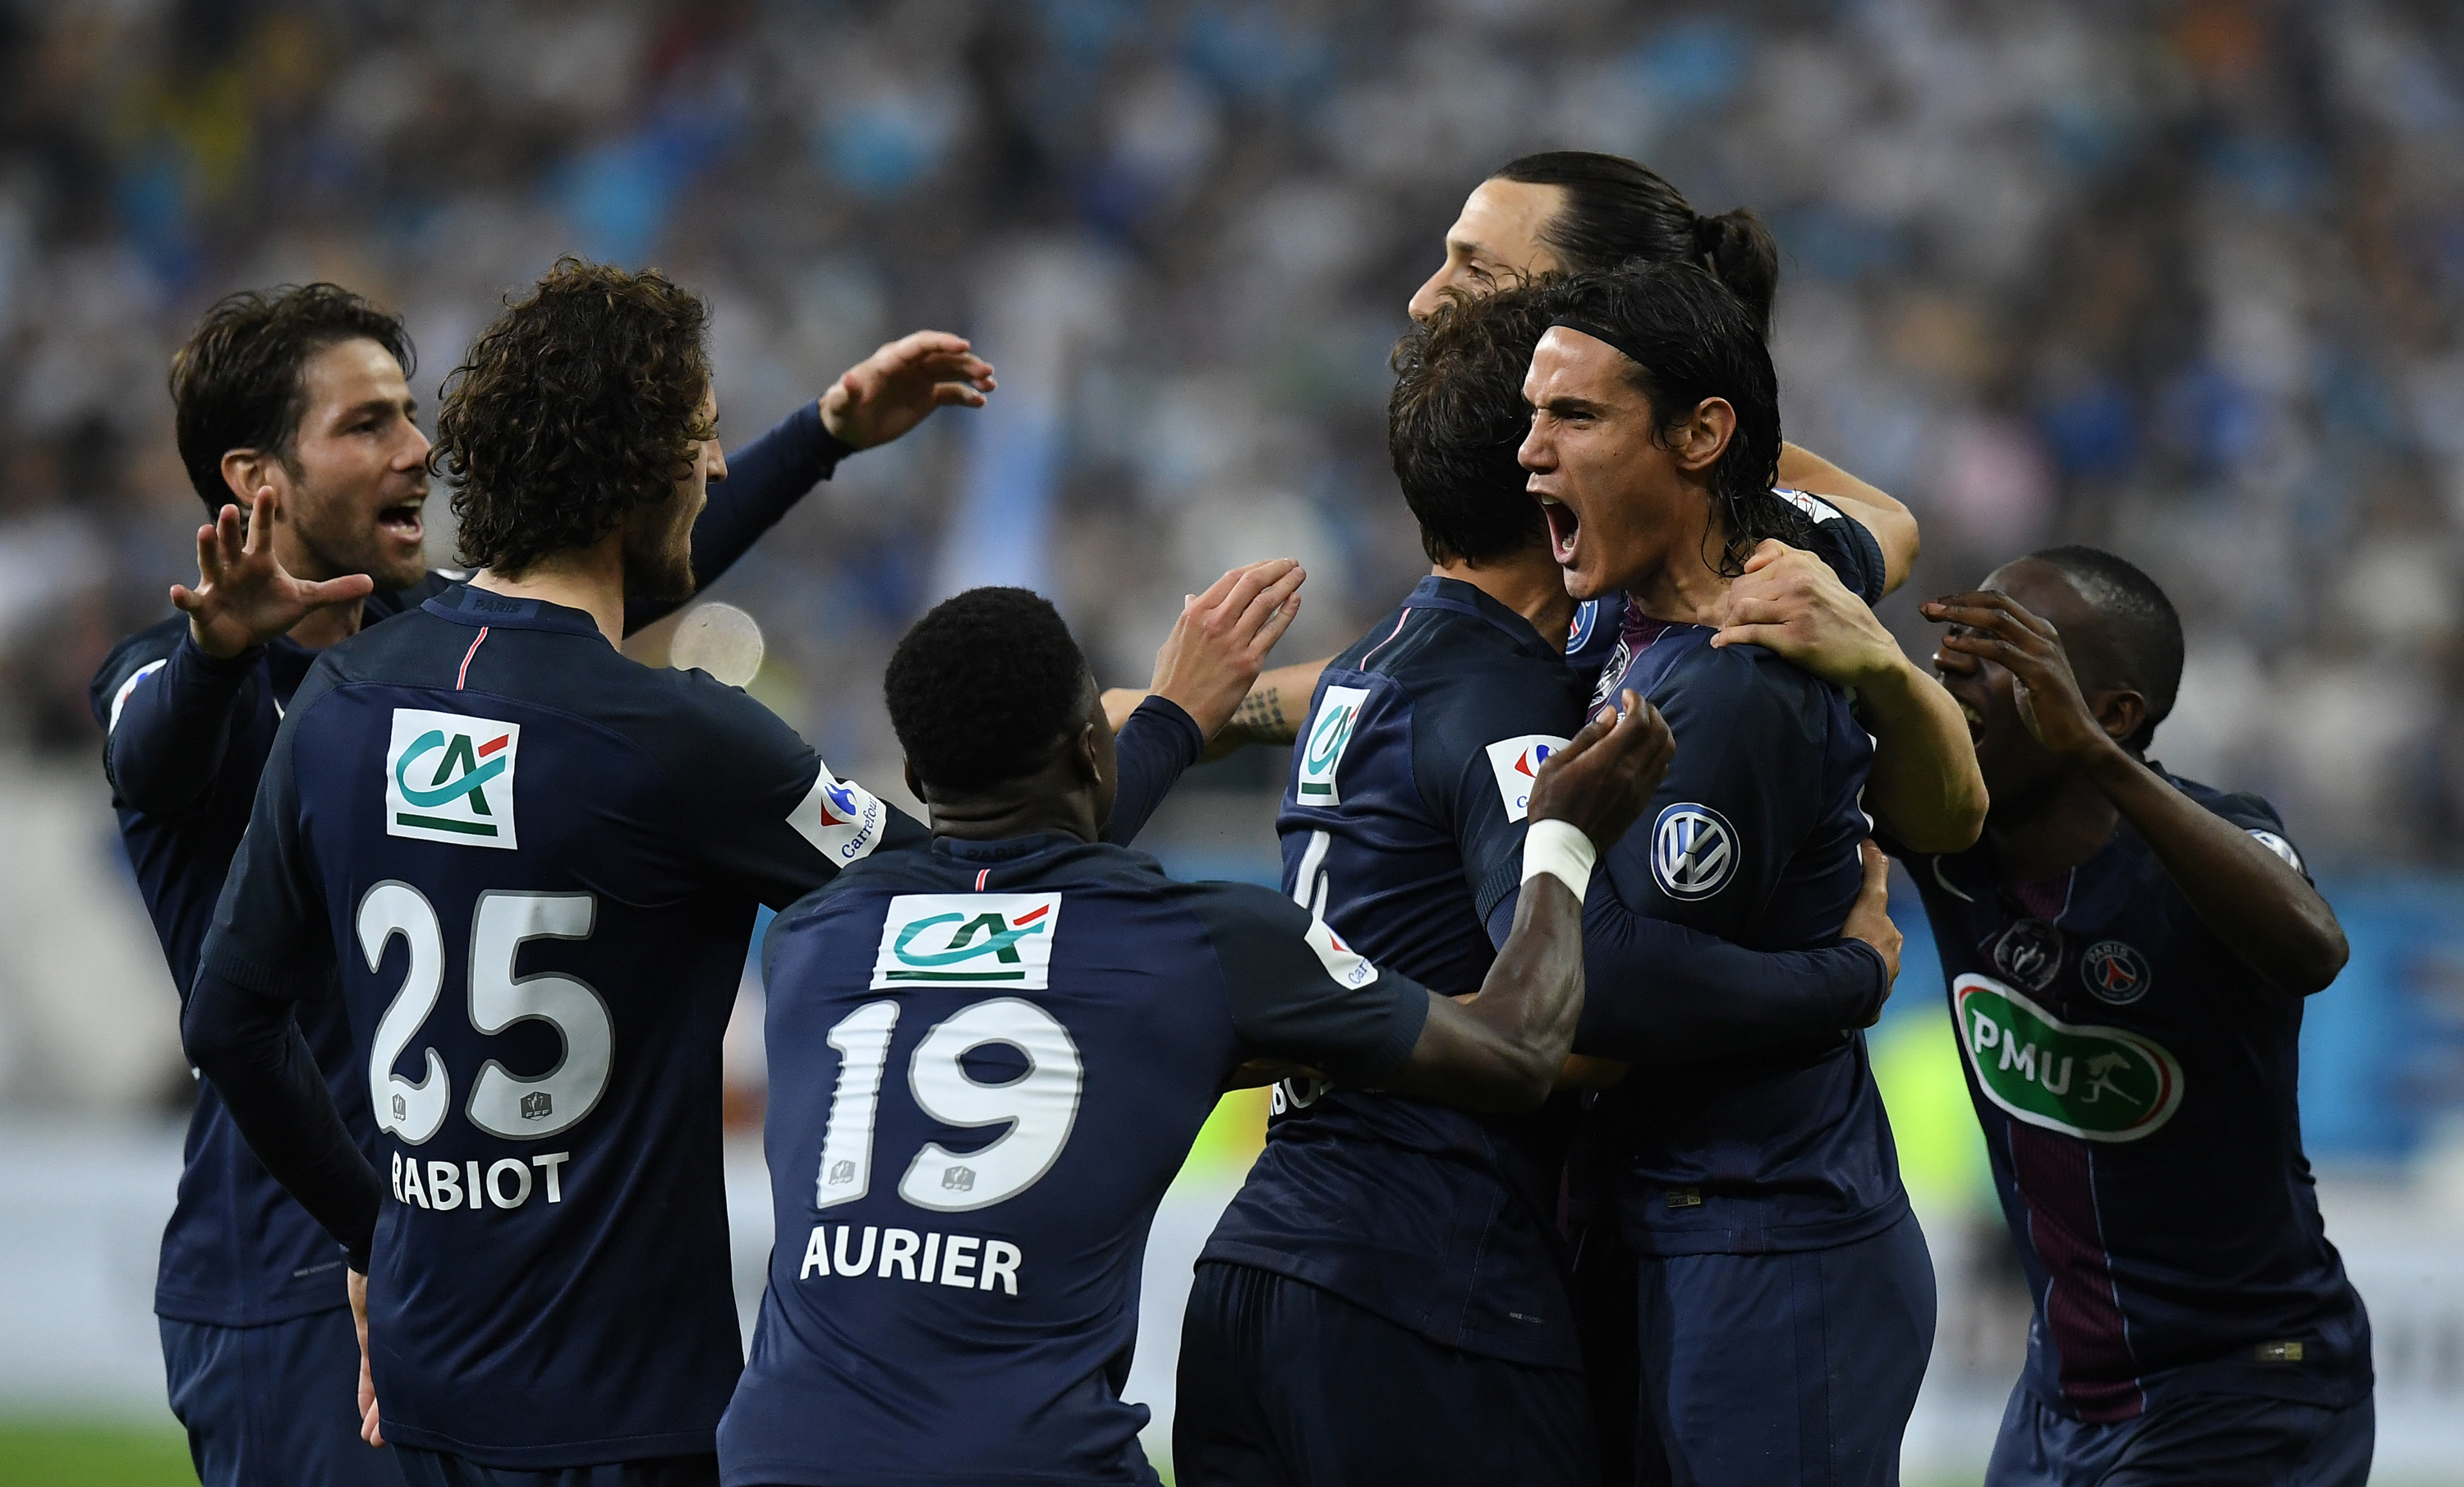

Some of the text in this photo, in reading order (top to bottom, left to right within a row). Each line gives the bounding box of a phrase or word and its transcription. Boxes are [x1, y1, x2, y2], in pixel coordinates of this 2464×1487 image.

[841, 796, 877, 859] Carrefour
[356, 879, 615, 1145] 25
[1970, 1009, 2073, 1095] PMU
[526, 1109, 549, 1117] FFF
[816, 997, 1084, 1213] 19
[392, 1150, 570, 1212] RABIOT
[799, 1225, 1023, 1296] AURIER
